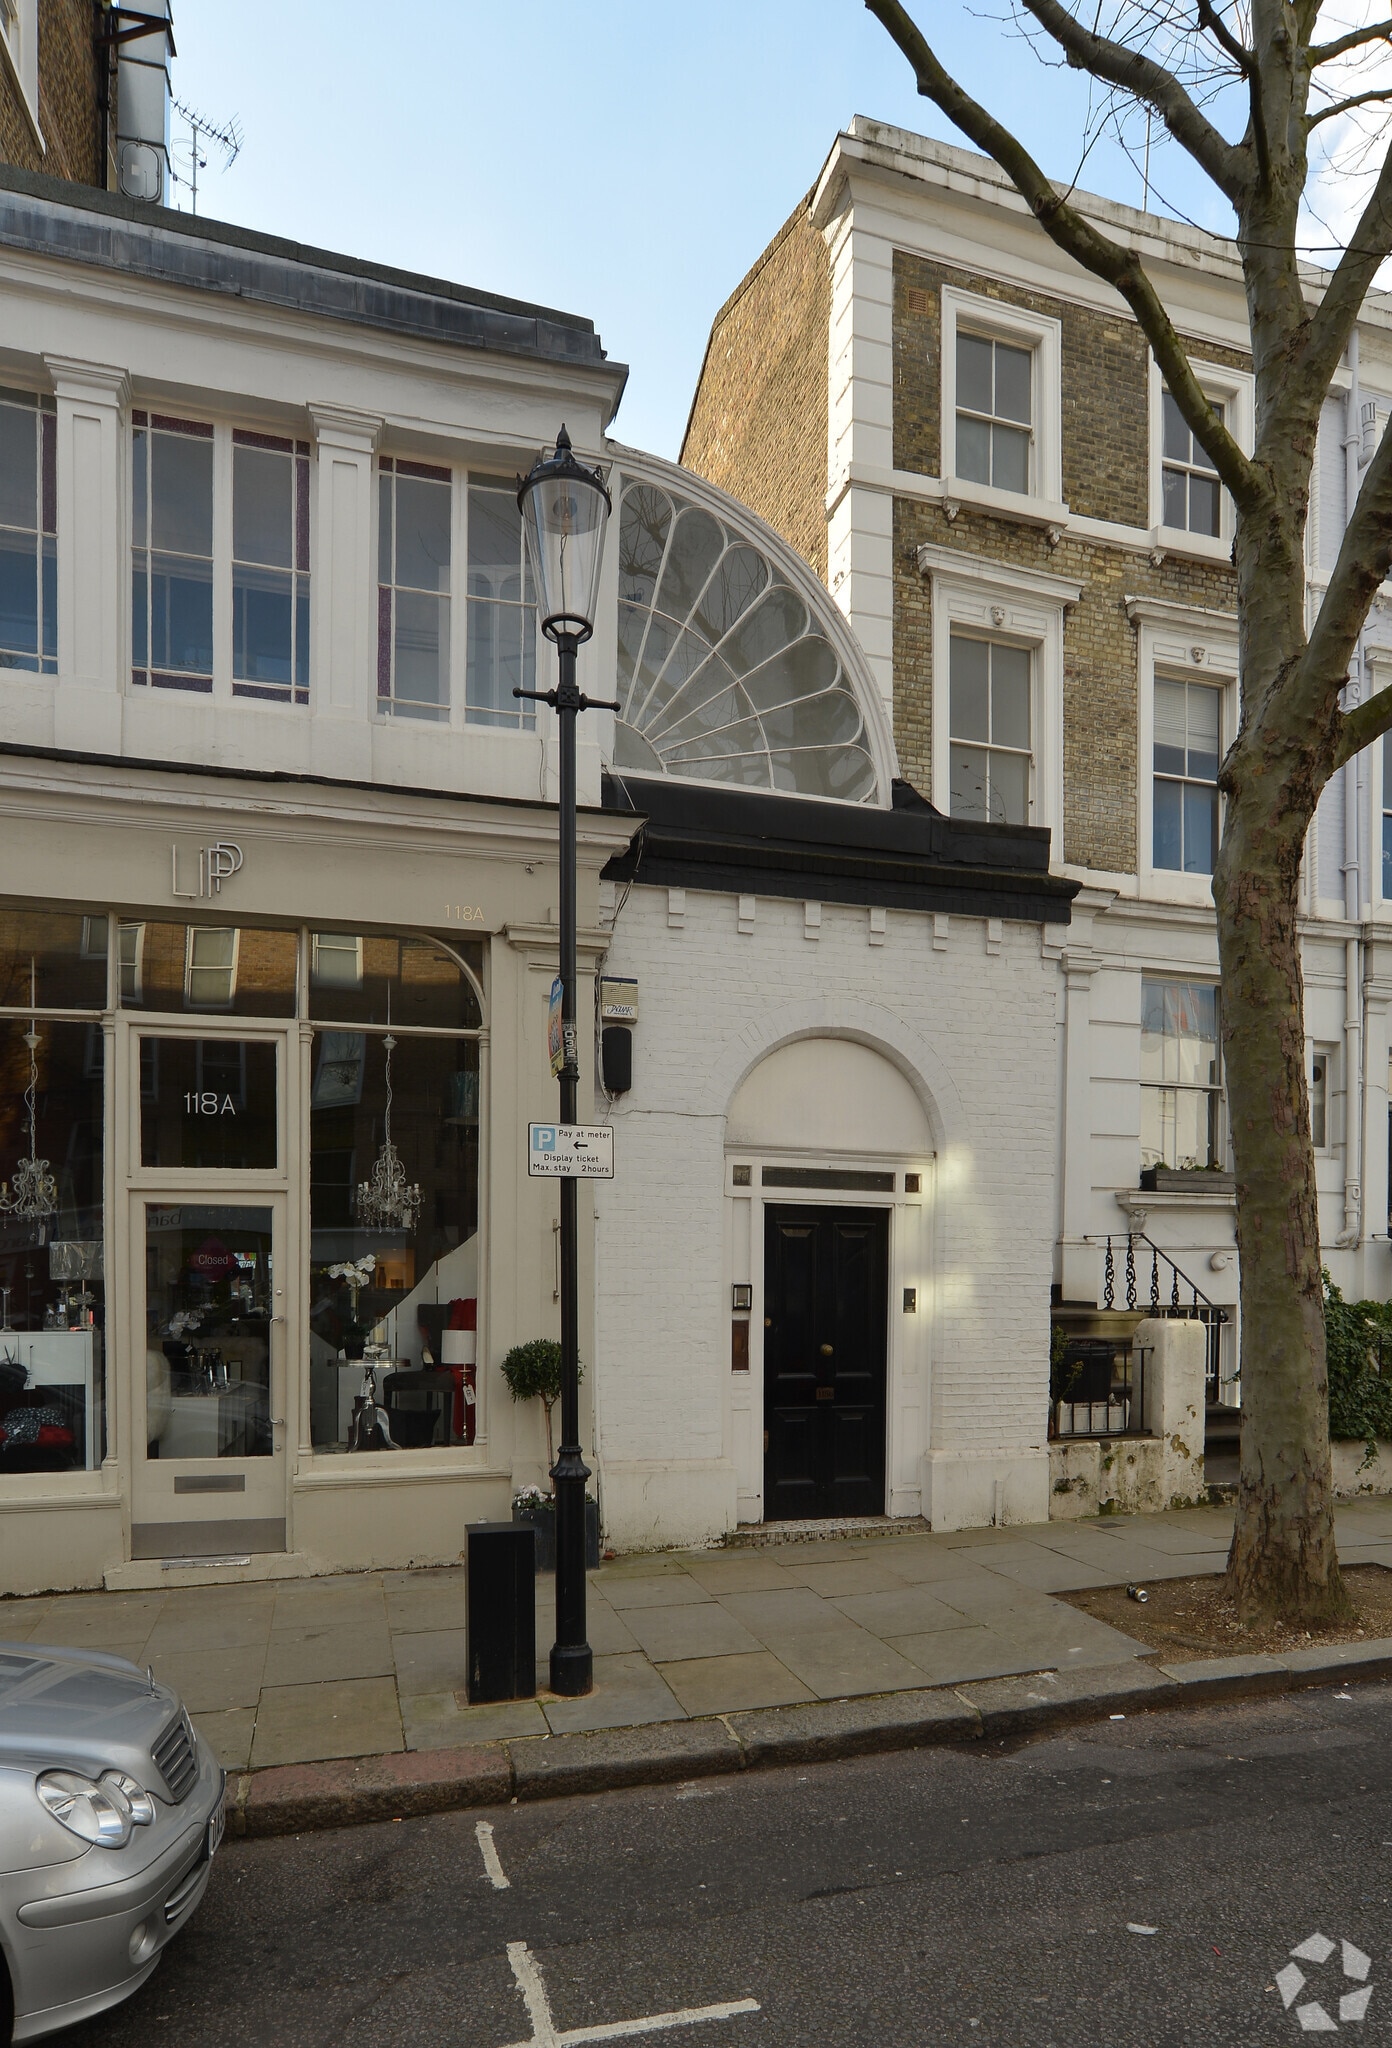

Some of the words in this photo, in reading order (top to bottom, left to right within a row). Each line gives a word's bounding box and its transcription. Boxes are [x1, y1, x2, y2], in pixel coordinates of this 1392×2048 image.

[444, 904, 485, 922] 118A
[183, 1092, 236, 1115] 118A
[538, 1130, 552, 1149] P
[558, 1129, 573, 1138] Pay
[575, 1130, 585, 1138] at
[587, 1131, 610, 1139] meter
[543, 1153, 573, 1163] Display
[576, 1155, 600, 1163] ticket
[532, 1163, 552, 1171] Max.
[554, 1164, 571, 1173] stay
[198, 1254, 229, 1265] Closed
